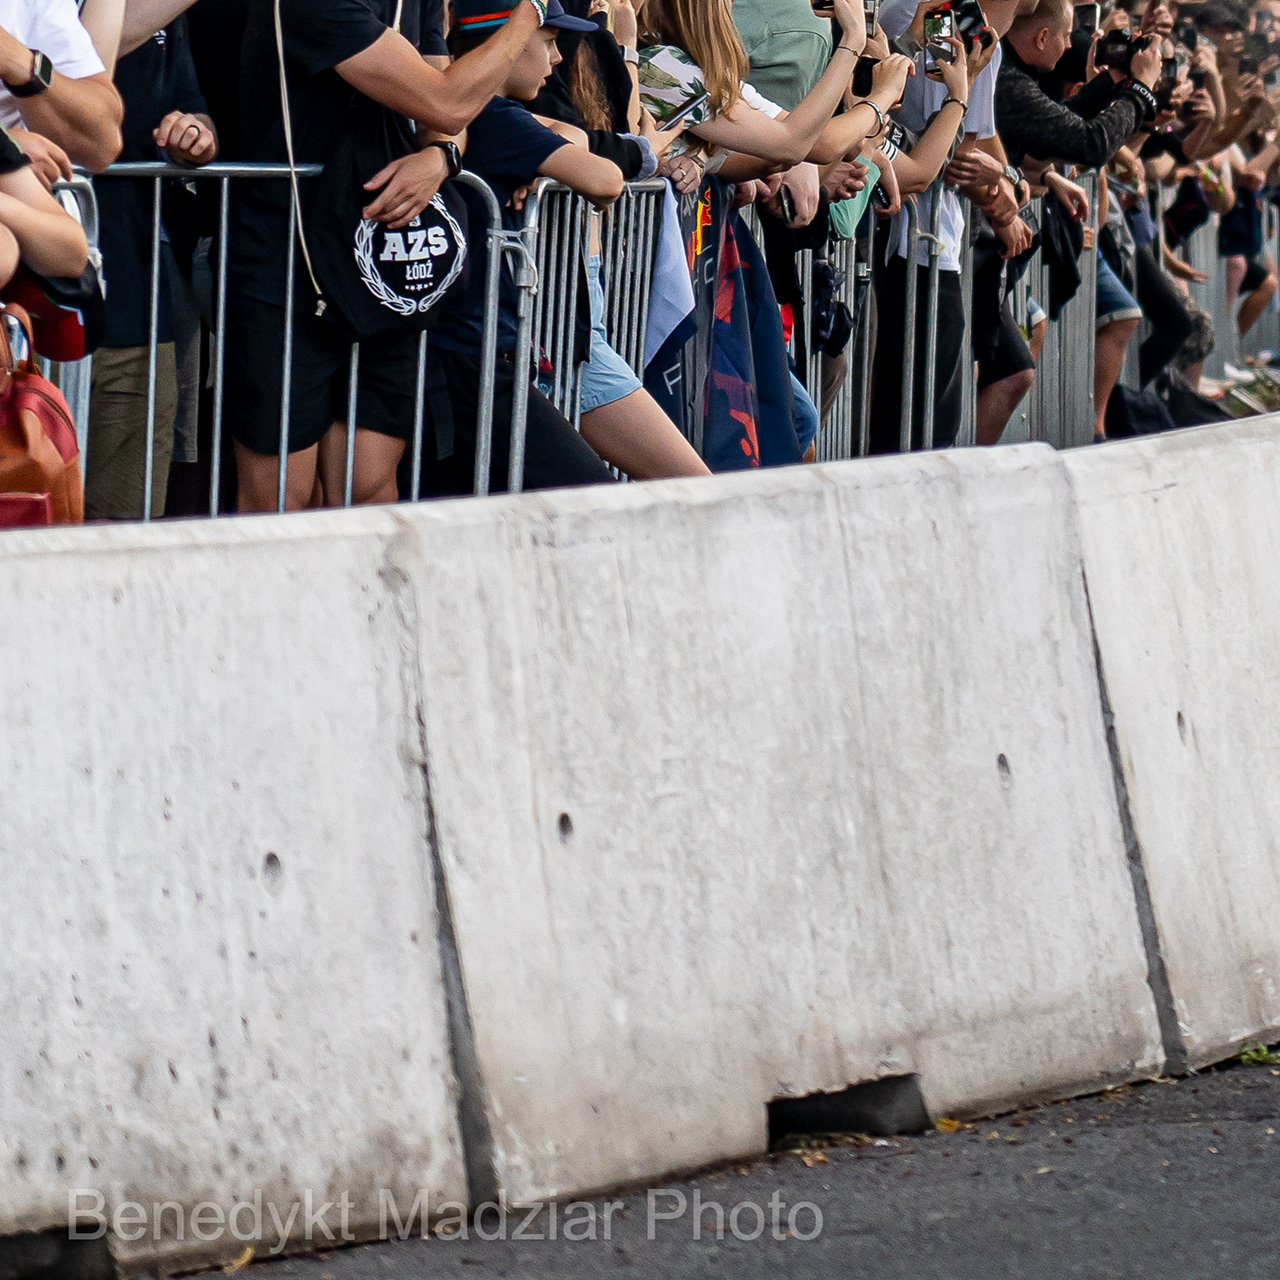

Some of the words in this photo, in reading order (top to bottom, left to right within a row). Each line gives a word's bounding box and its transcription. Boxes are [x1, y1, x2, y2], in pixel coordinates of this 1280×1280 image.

[1132, 83, 1157, 107] SONY
[379, 226, 449, 261] AZS
[405, 259, 434, 281] ŁÓDŹ
